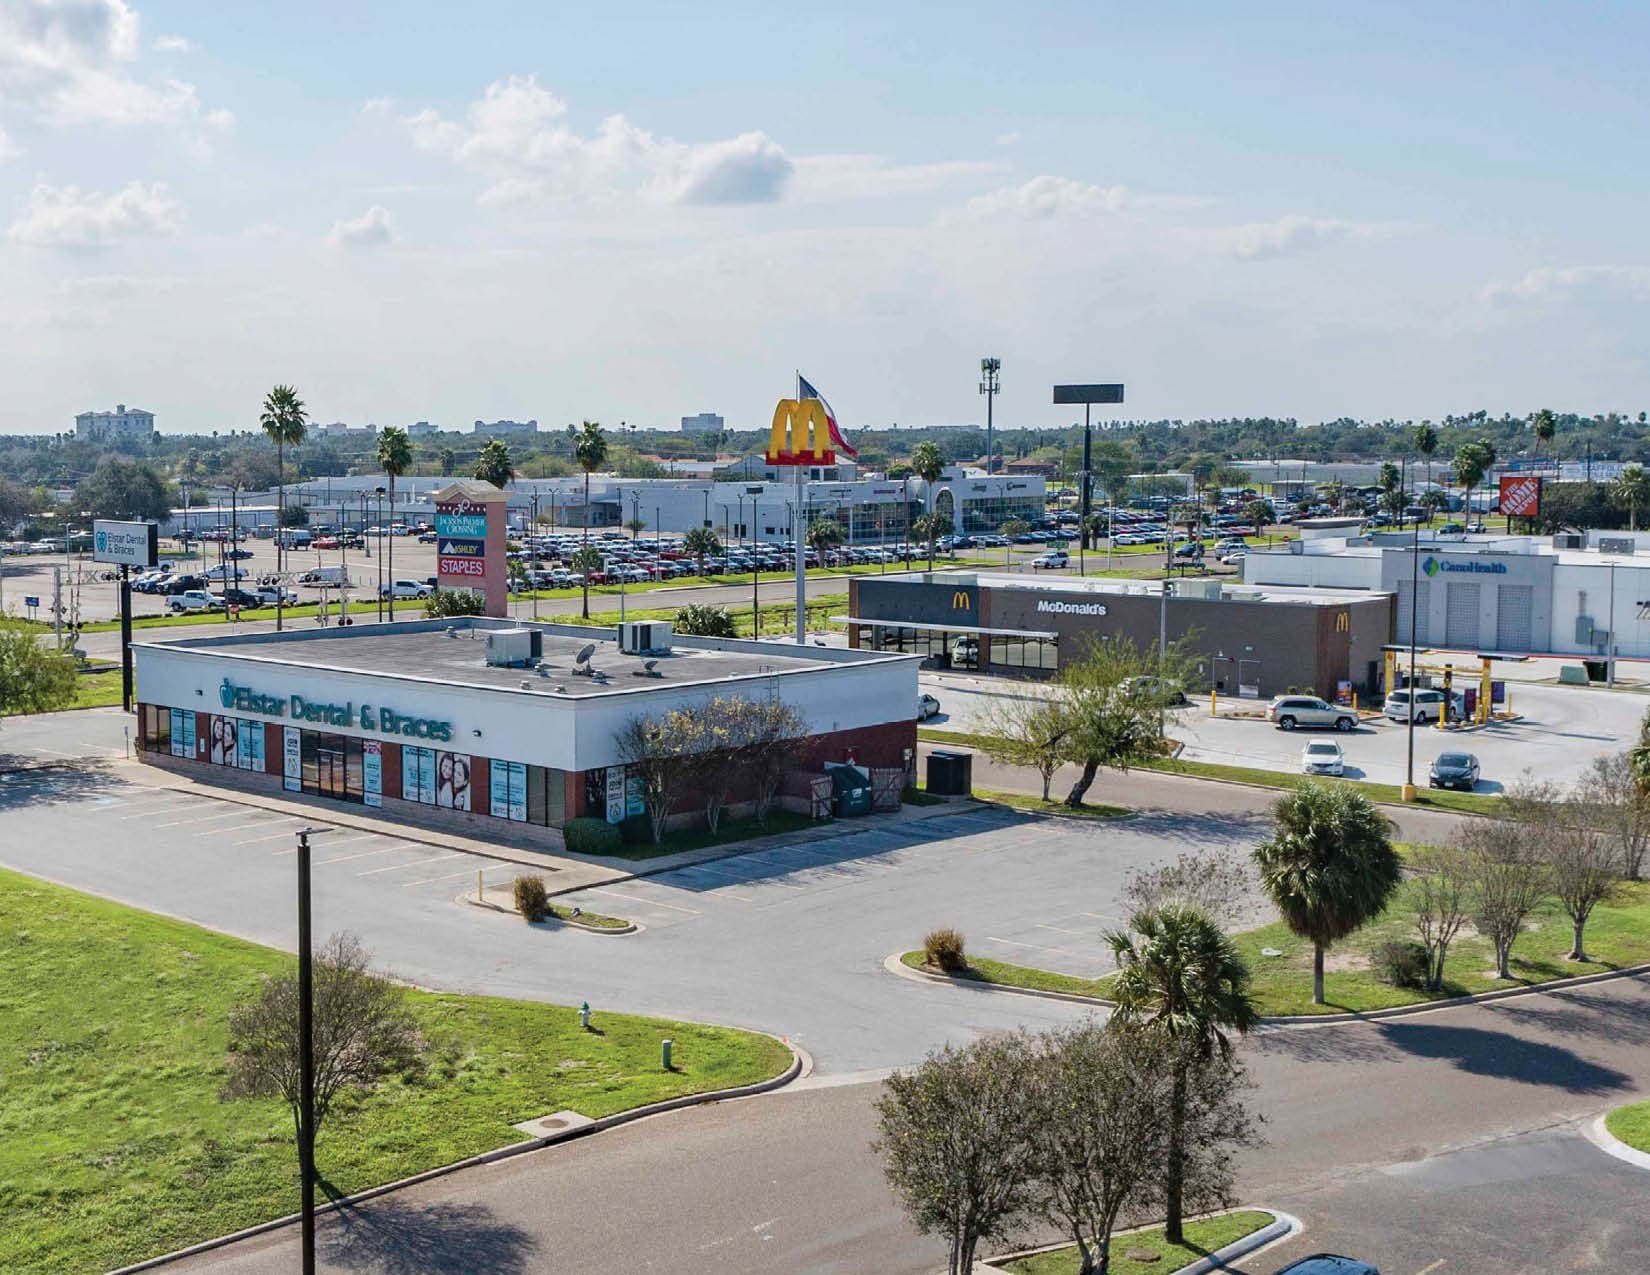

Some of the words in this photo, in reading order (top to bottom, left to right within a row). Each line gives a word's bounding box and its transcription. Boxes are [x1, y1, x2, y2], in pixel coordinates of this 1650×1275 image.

[1500, 478, 1538, 514] HOME
[107, 532, 125, 544] Elstar
[126, 533, 146, 545] Dental
[107, 543, 113, 553] &
[114, 544, 135, 555] Braces
[442, 541, 478, 554] ASHLEY
[441, 560, 483, 575] STAPLES
[1037, 600, 1107, 616] McDonald's
[234, 687, 287, 716] Elstar
[290, 694, 353, 728] Dental
[360, 704, 375, 730] &
[380, 707, 452, 742] Braces
